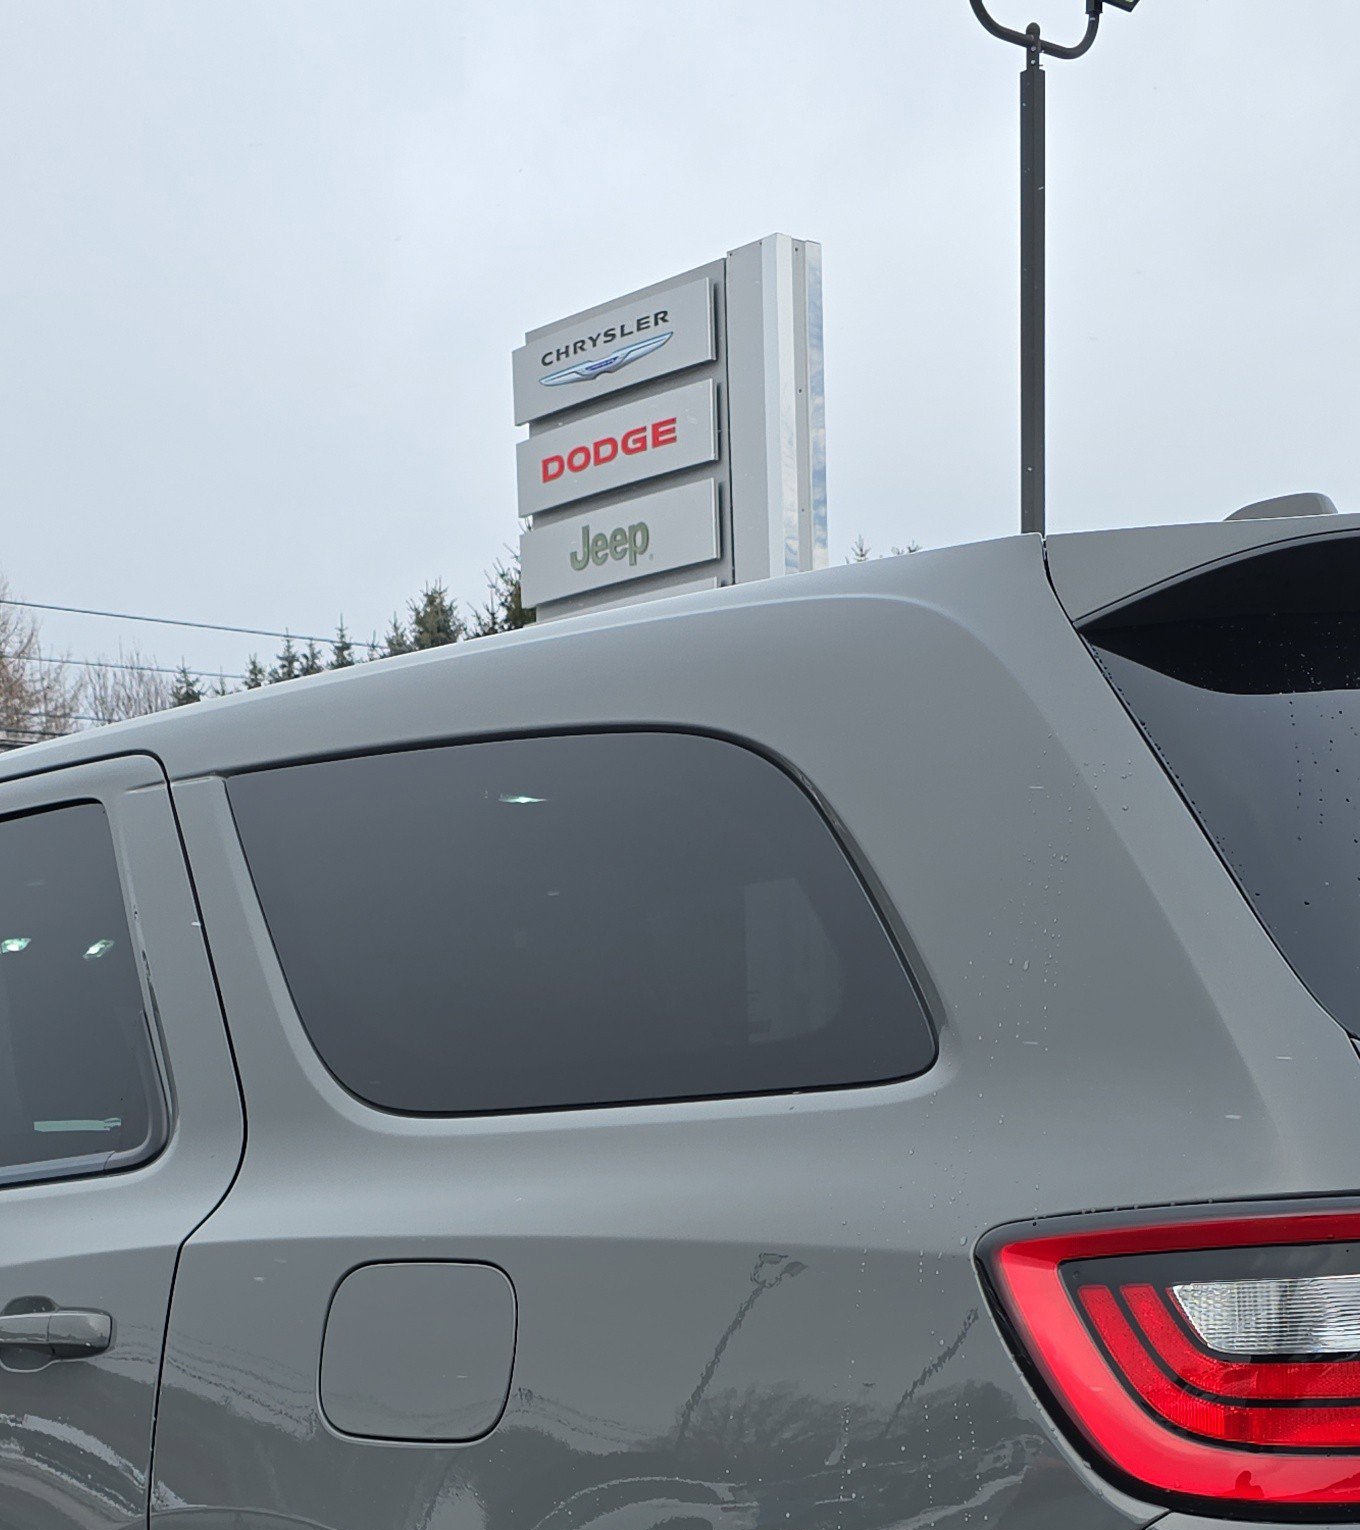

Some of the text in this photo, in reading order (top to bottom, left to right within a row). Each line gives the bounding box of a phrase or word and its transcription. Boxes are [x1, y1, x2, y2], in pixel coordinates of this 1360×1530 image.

[541, 310, 670, 367] CHRYSLER
[541, 416, 678, 484] DODGE
[569, 521, 650, 572] Jeep
